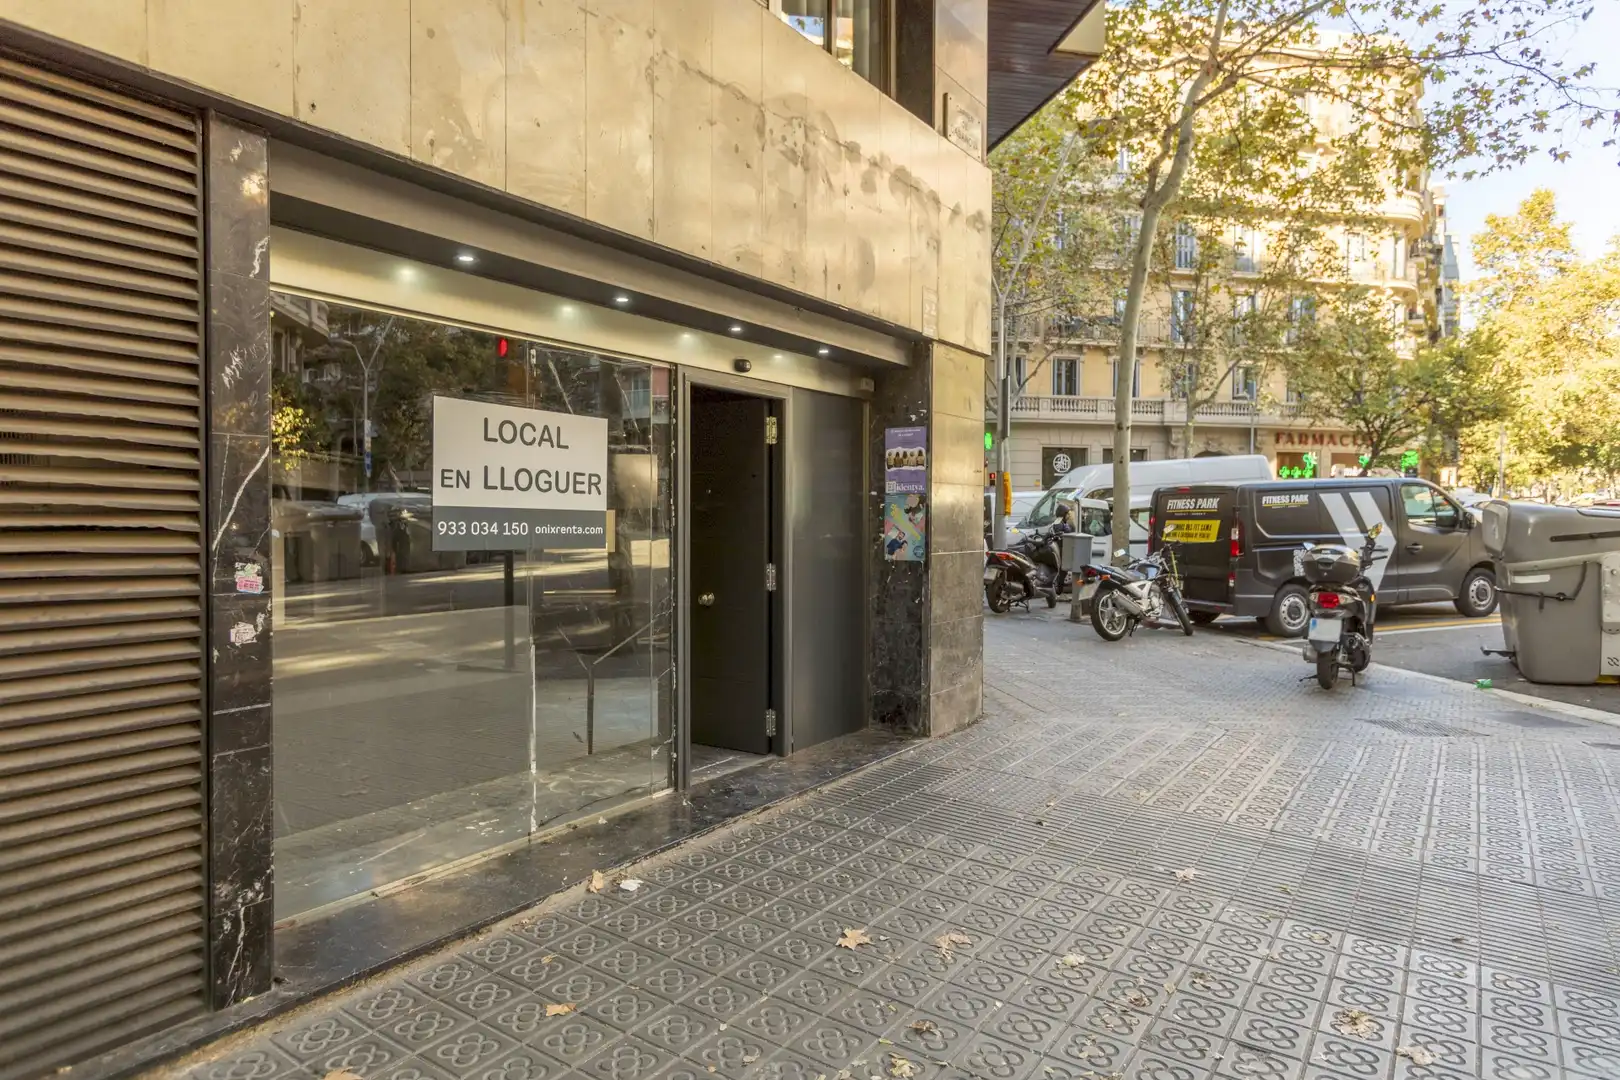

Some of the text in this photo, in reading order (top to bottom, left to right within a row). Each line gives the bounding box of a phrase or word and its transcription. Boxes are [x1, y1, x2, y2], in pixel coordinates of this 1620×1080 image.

[484, 417, 569, 449] LOCAL
[441, 465, 602, 495] EN LLOGUER
[1166, 498, 1220, 510] FITNESS PARK
[1262, 494, 1309, 505] FITNESS PARK
[437, 521, 603, 535] 933 034 150 onixrenta.com
